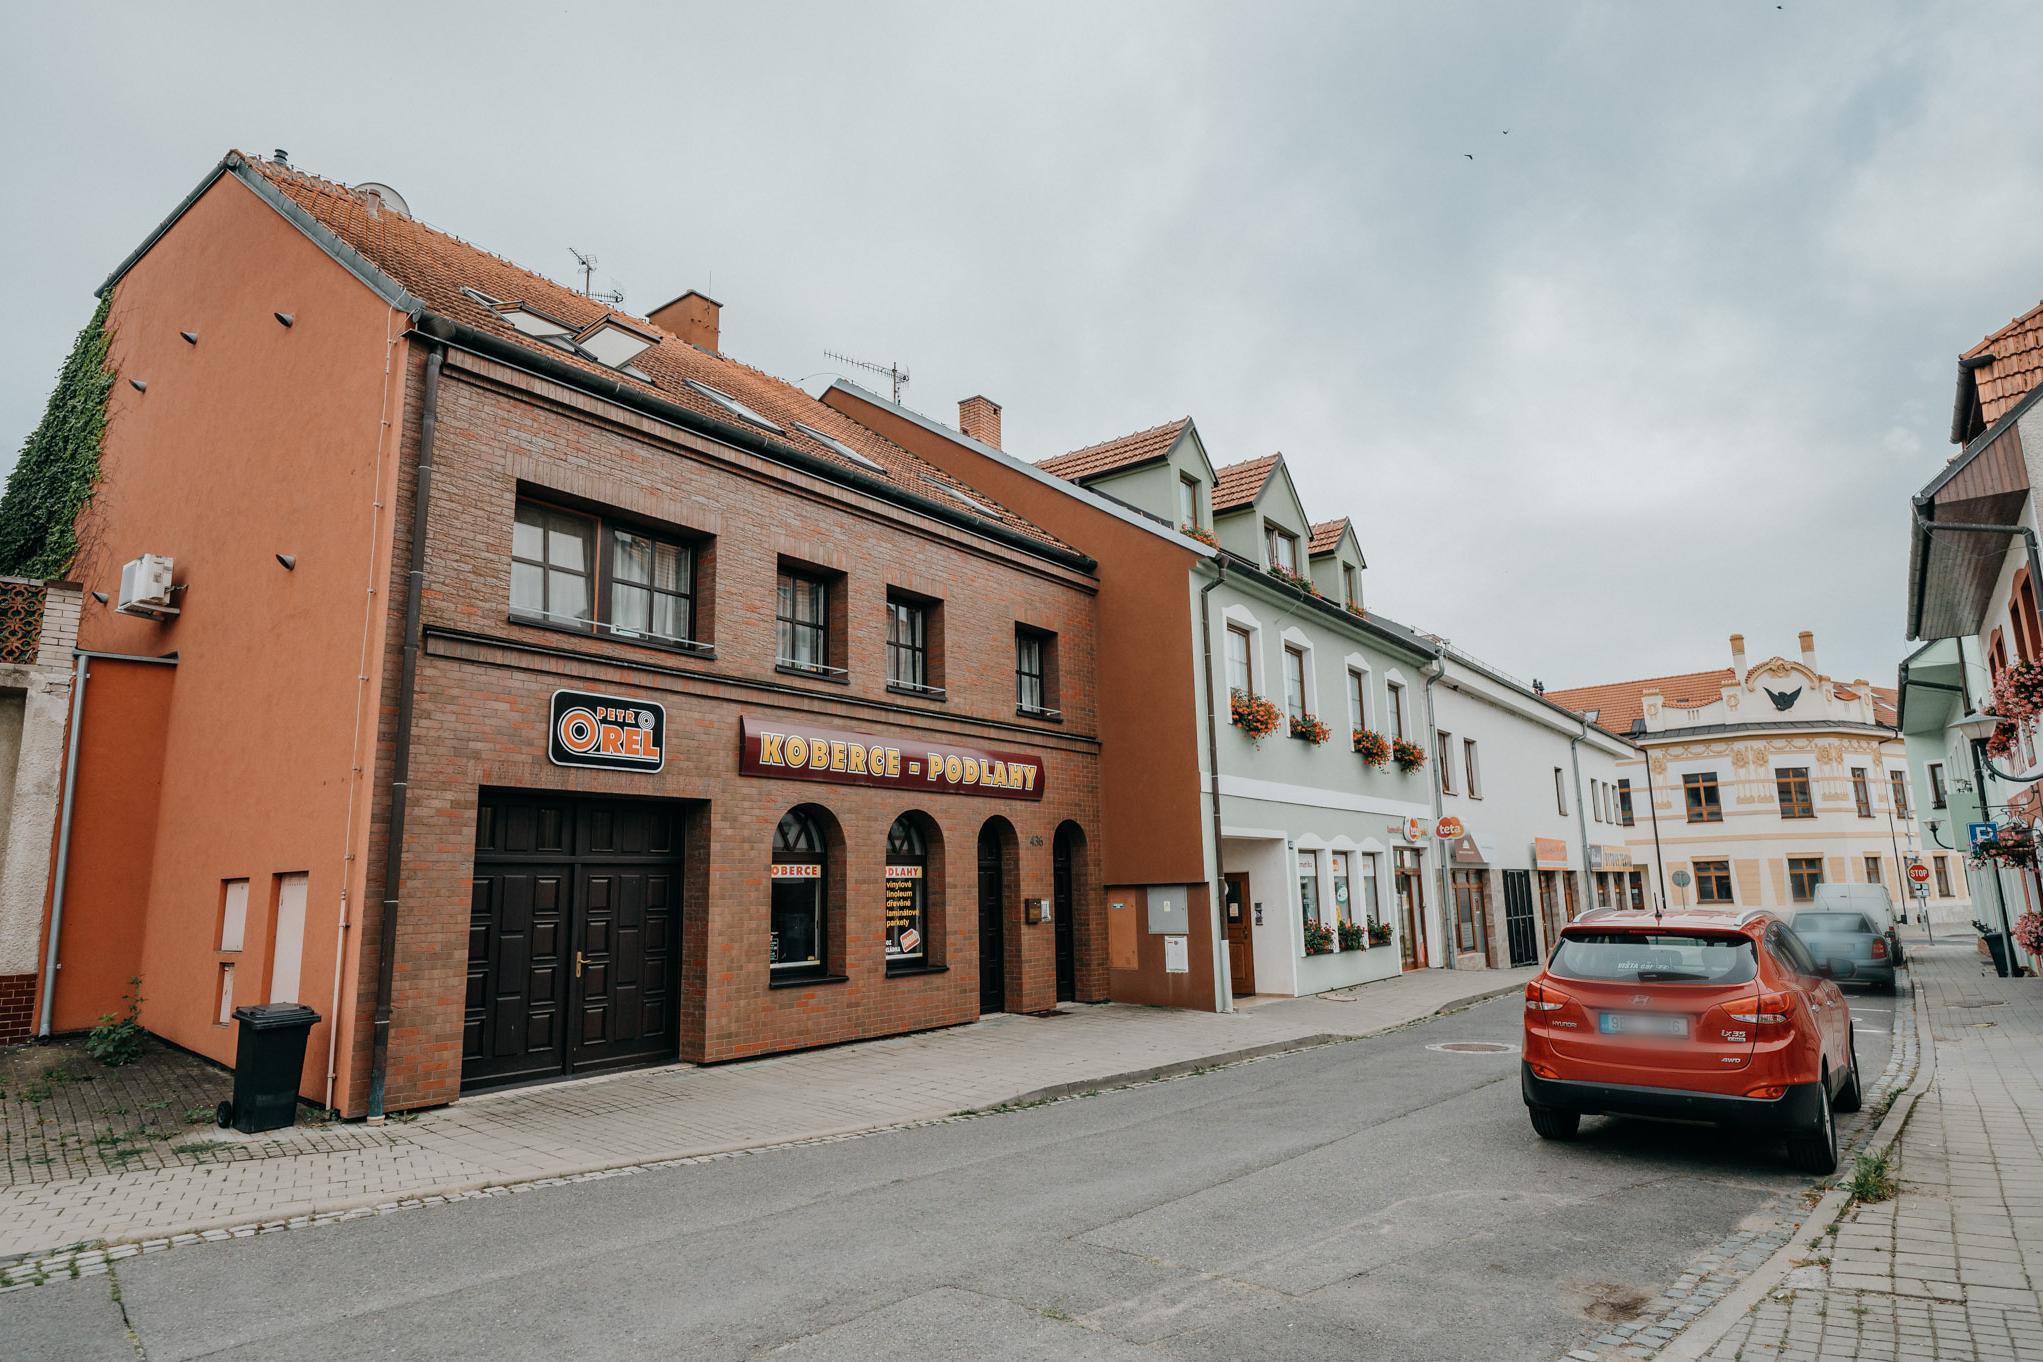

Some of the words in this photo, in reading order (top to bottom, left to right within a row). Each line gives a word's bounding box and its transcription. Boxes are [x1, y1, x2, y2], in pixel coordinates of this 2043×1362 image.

[597, 706, 635, 723] PETR
[557, 706, 660, 760] OREL
[759, 731, 900, 778] KOBERCE
[908, 762, 921, 775] -
[927, 752, 1037, 790] PODLAHY
[1440, 824, 1461, 834] teta
[886, 867, 918, 877] DLAHY
[1910, 869, 1928, 877] STOP
[886, 890, 912, 898] linoleum
[886, 918, 909, 928] parkety
[1552, 1020, 1577, 1028] HYUNDAI
